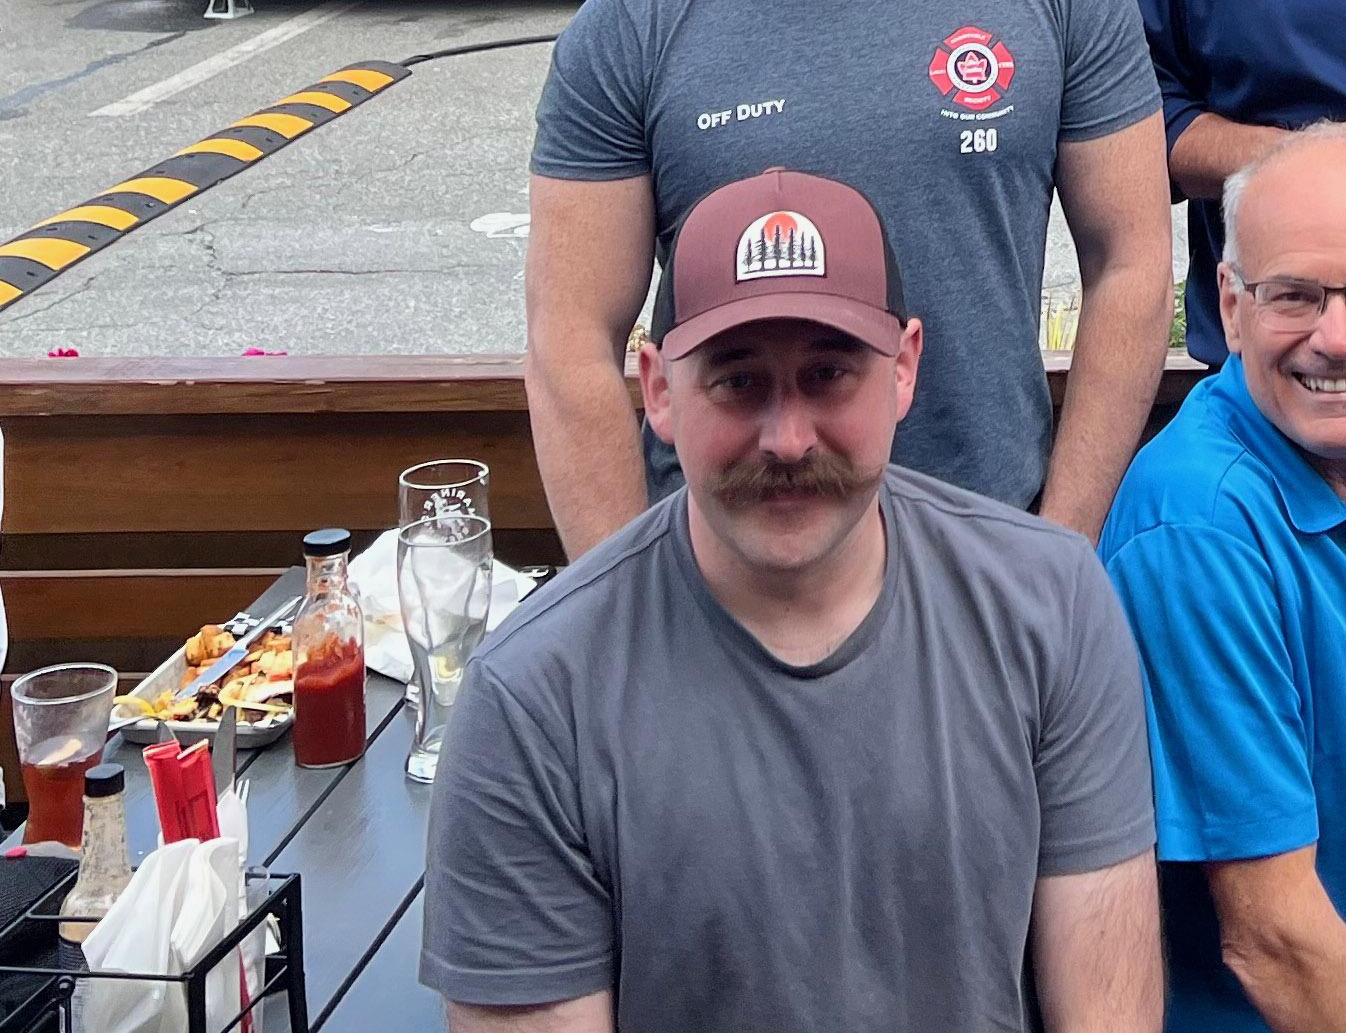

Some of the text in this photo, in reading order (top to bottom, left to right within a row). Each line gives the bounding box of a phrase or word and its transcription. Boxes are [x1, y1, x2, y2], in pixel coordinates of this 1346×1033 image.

[697, 99, 786, 130] OFF DUTY
[960, 128, 998, 154] 260
